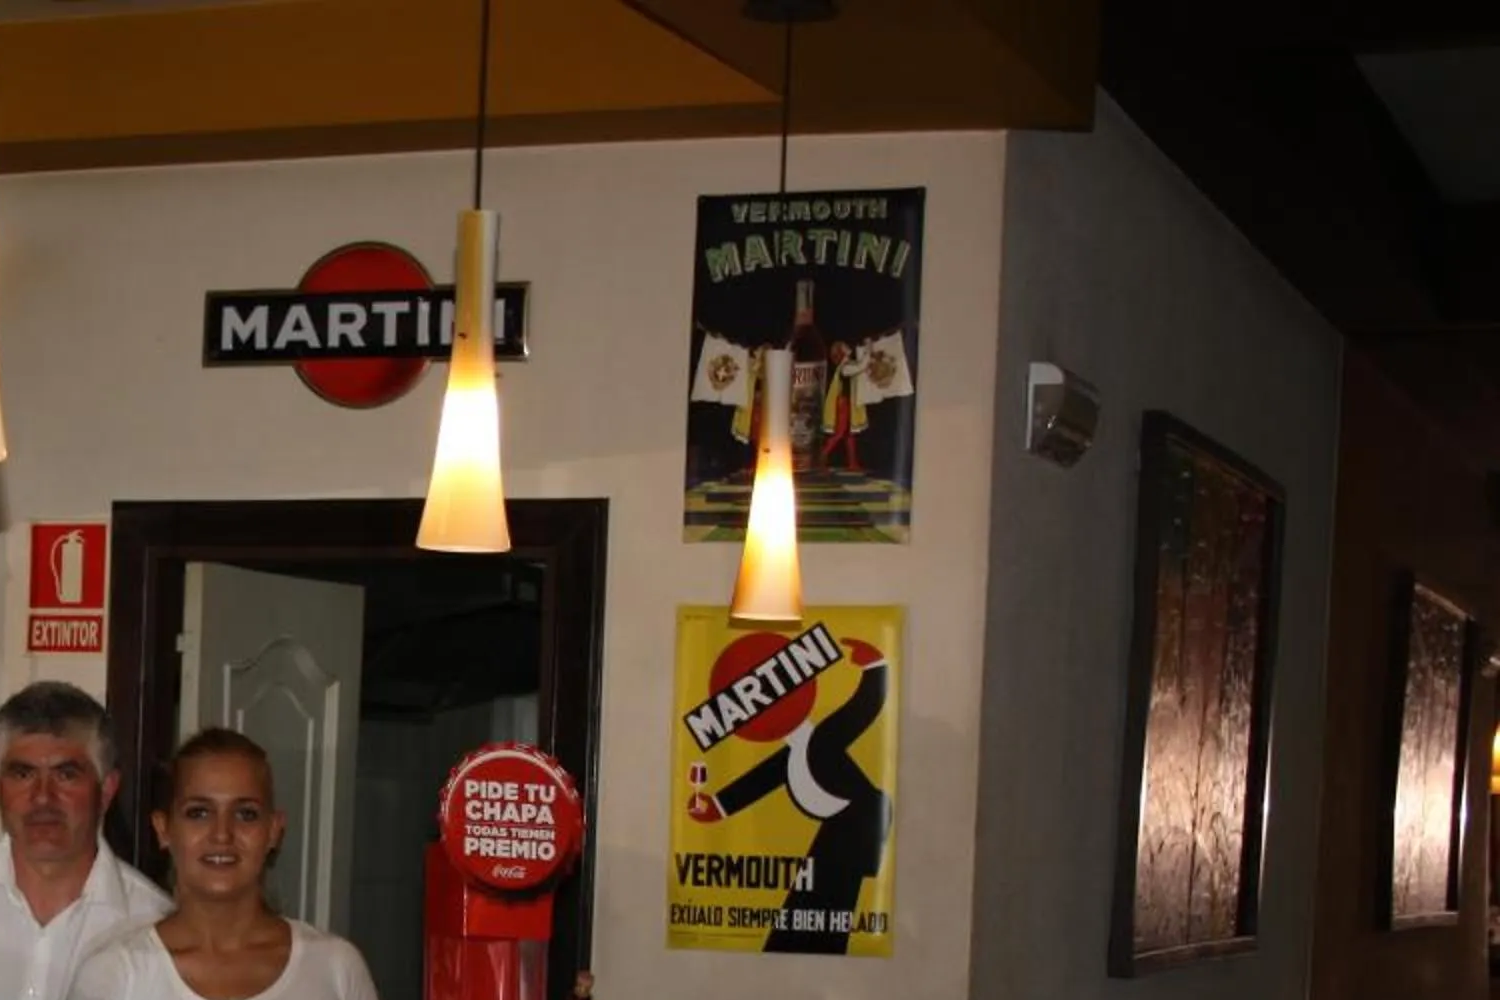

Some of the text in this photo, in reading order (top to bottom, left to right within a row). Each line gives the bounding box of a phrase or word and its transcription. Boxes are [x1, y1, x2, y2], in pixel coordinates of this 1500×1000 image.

[731, 197, 888, 223] VERMOUTH
[705, 229, 911, 283] MARTINI
[32, 620, 99, 648] EXTINTOR
[686, 625, 840, 749] MARTINI
[464, 780, 556, 803] PIDE TU
[465, 801, 555, 824] CHAPA
[465, 824, 556, 841] TODAS TIENEN
[464, 836, 556, 861] PREMIO
[675, 853, 814, 891] VERMOUTH
[727, 905, 789, 931] SIEMPRE
[792, 908, 826, 932] BIEN
[829, 910, 888, 934] HELADO
